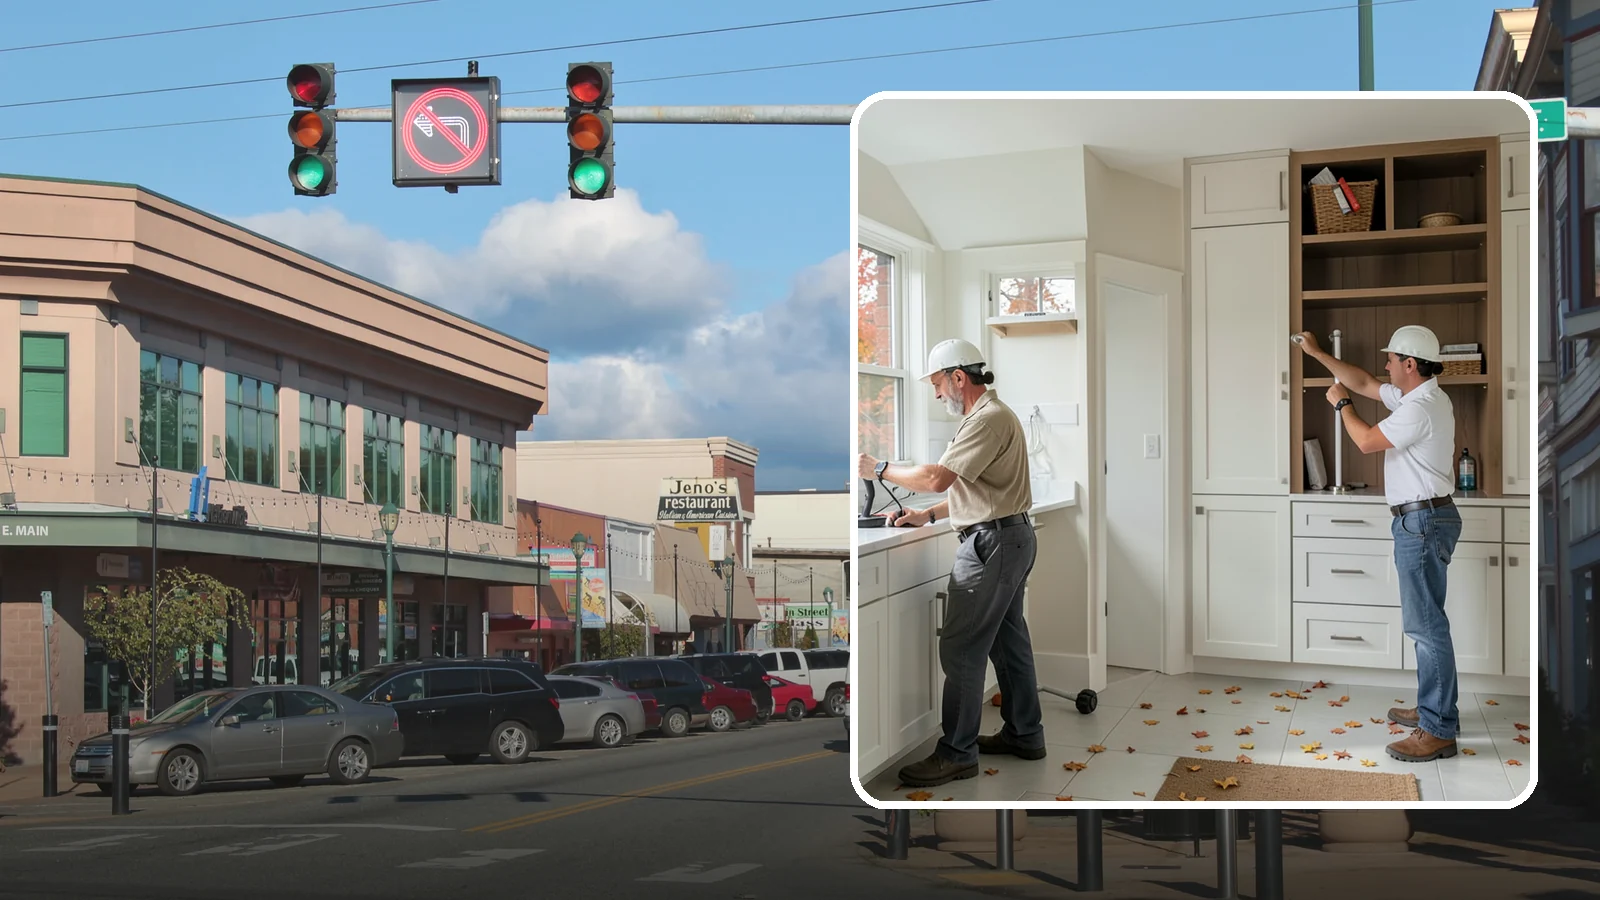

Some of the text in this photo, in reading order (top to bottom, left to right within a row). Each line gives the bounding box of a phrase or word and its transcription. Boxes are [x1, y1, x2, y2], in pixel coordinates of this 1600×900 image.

[669, 480, 727, 494] Jeno's
[665, 496, 731, 509] restaurant
[658, 510, 681, 519] Italian
[686, 510, 714, 519] American
[715, 510, 737, 519] Cuisine
[2, 525, 49, 536] E. MAIN
[797, 607, 828, 617] Street
